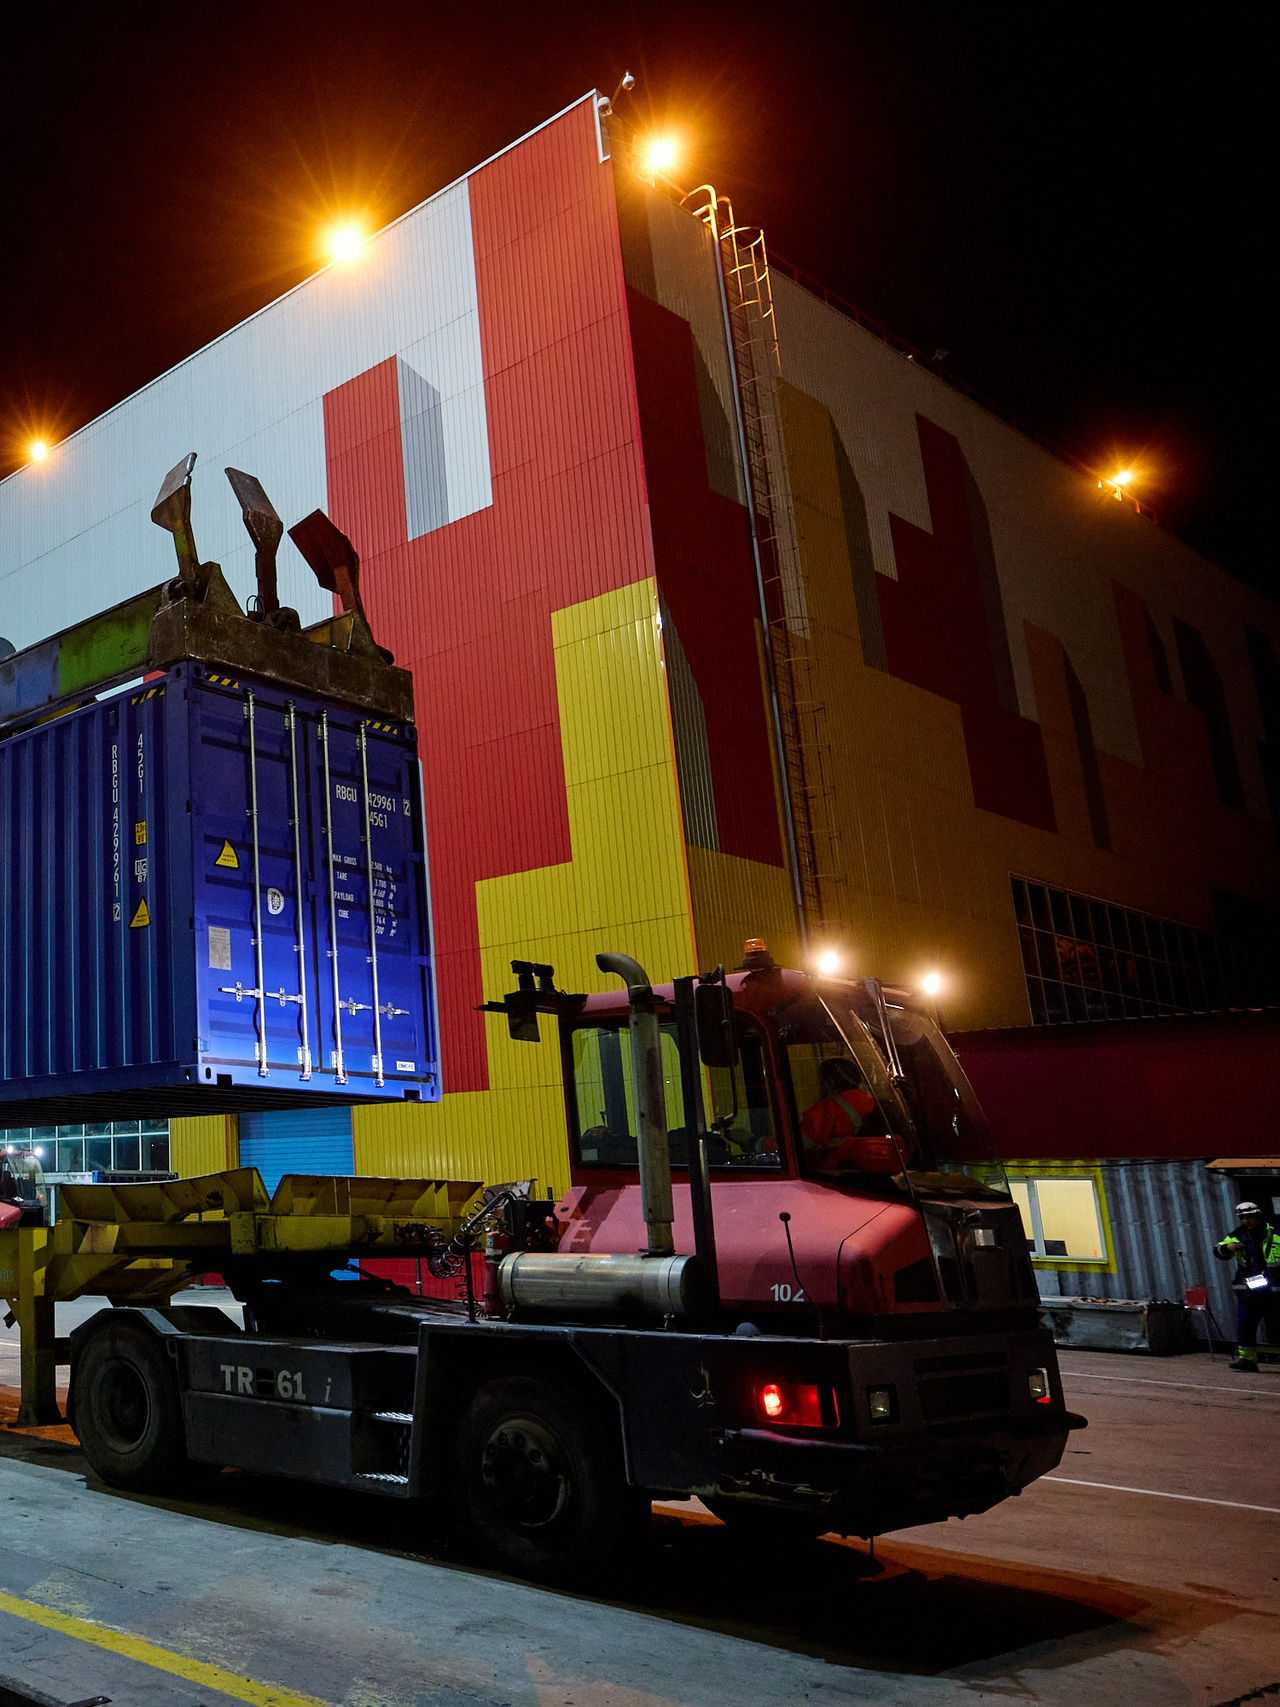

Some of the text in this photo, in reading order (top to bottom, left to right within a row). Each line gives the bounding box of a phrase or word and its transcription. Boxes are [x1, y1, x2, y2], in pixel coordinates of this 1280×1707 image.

[111, 744, 119, 803] RBGU
[335, 784, 357, 803] RBGU
[368, 792, 396, 812] 429961
[369, 811, 388, 829] 45G1
[112, 807, 120, 897] 429961
[336, 871, 348, 881] TARE
[334, 890, 354, 902] PAYLOAD
[220, 1364, 307, 1401] TR 61
